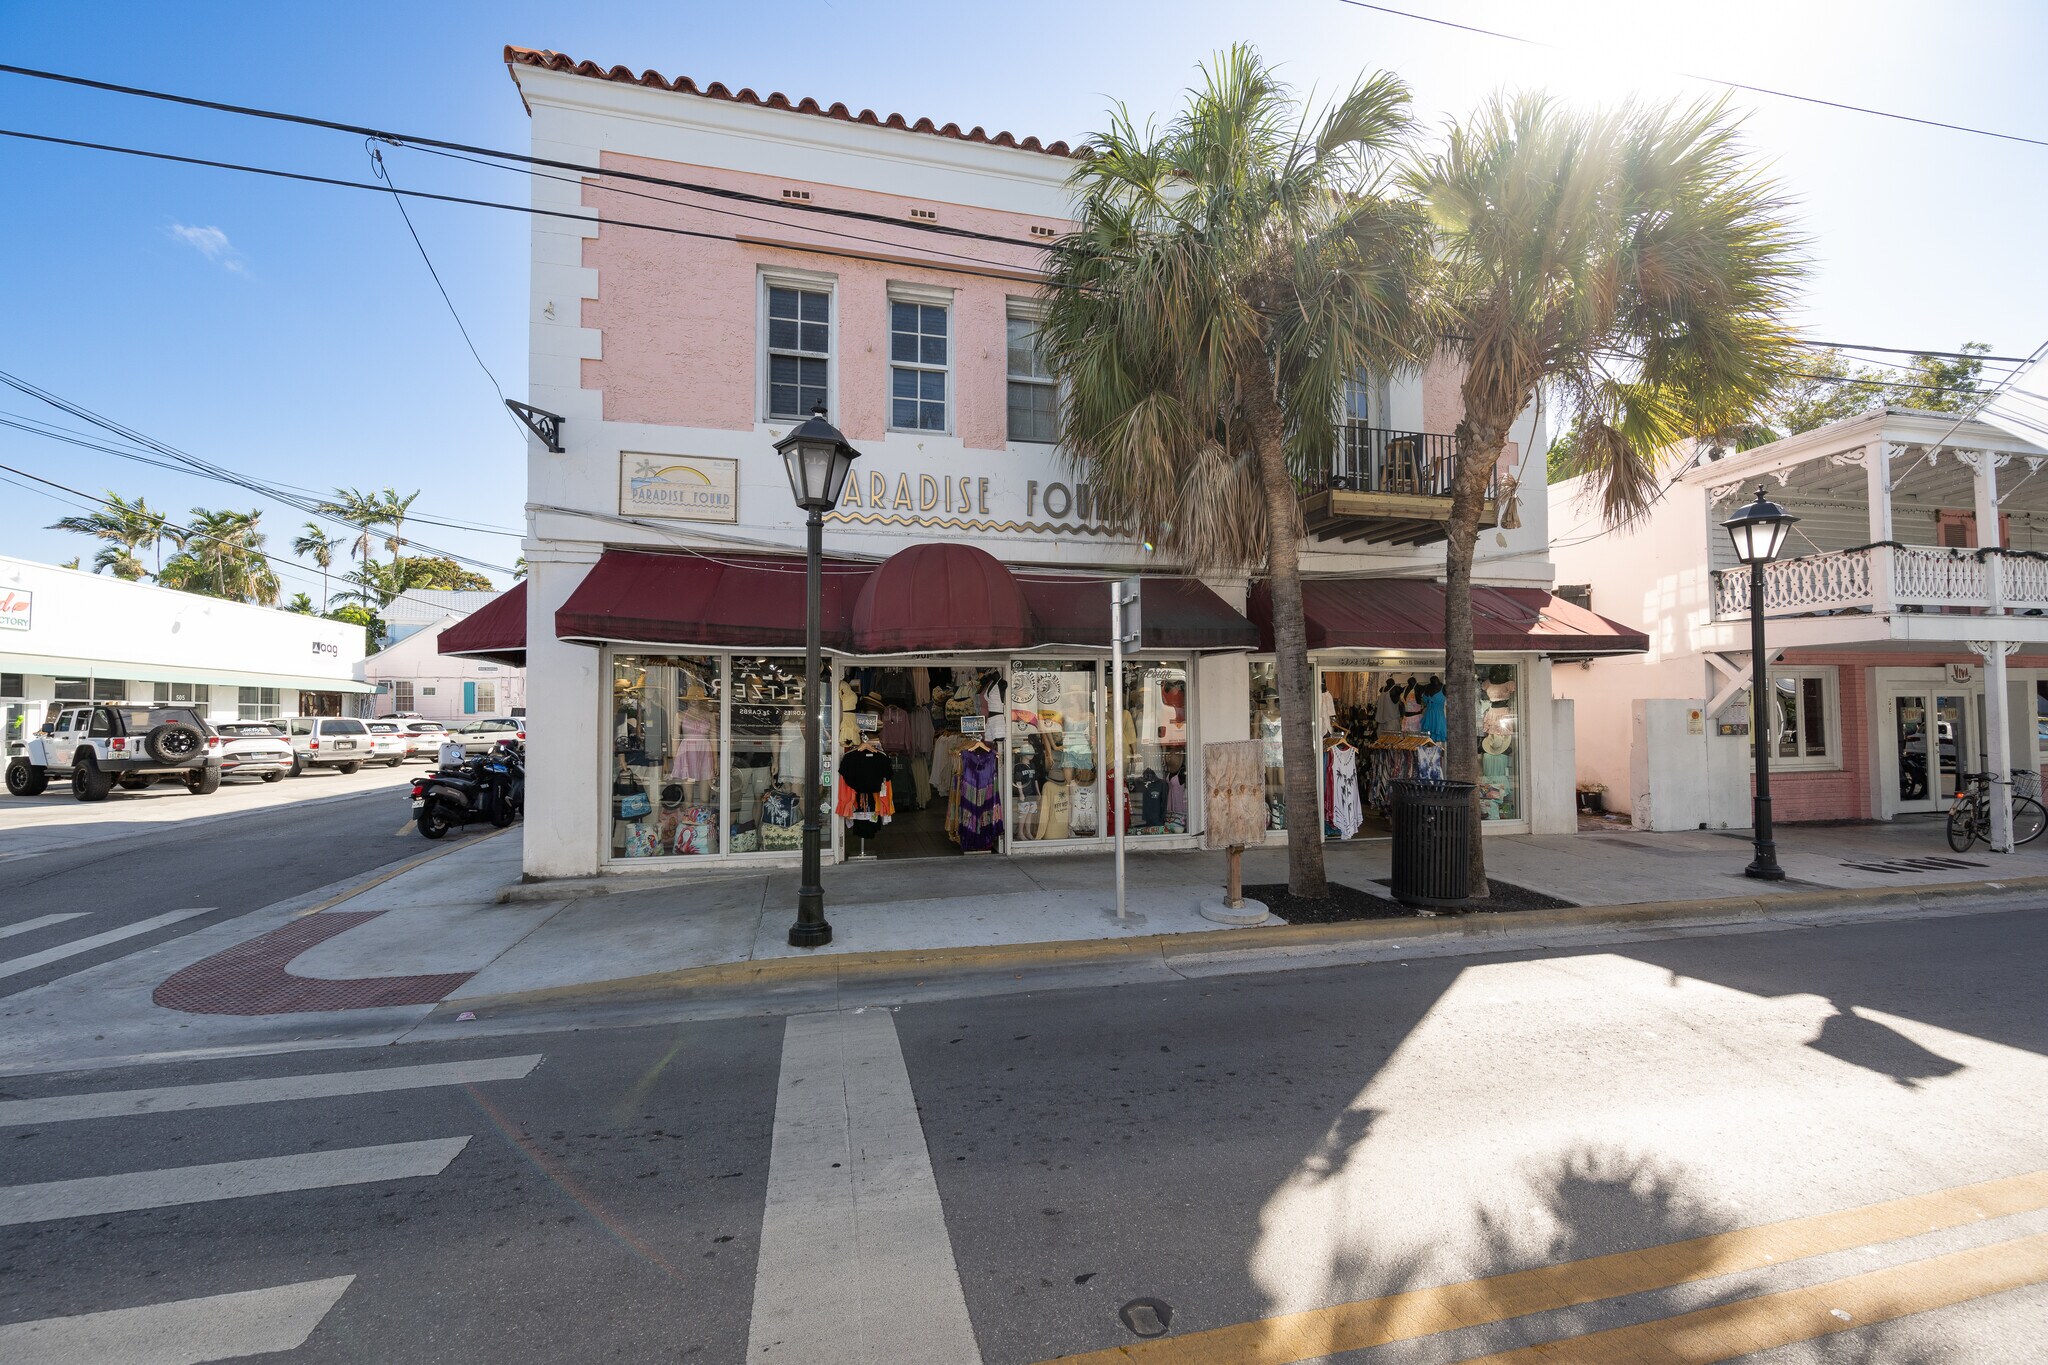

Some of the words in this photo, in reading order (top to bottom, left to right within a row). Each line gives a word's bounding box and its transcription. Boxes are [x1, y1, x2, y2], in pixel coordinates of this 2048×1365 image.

[632, 488, 685, 503] PARADISE
[693, 491, 730, 506] FOUND
[842, 469, 990, 515] ARADISE
[1027, 480, 1113, 521] FOU
[1953, 664, 1970, 679] VIVA
